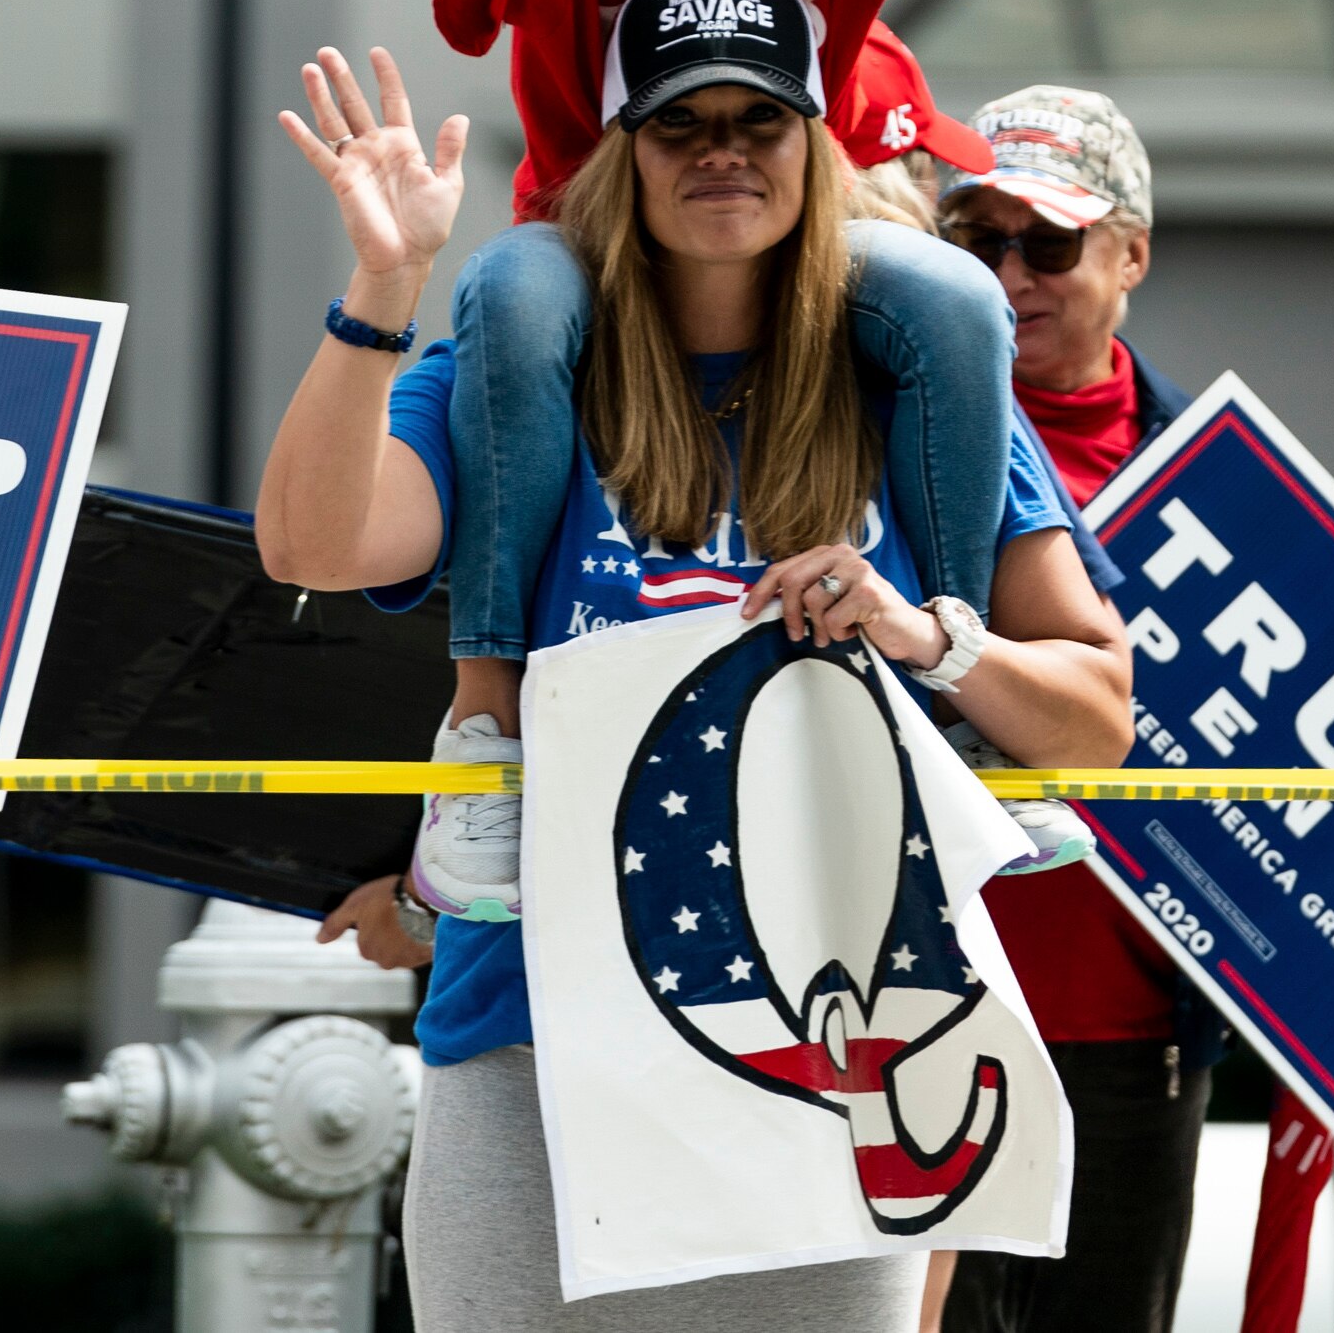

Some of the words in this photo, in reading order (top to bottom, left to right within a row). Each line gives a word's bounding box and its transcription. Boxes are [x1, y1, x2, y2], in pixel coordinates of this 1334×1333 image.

[696, 20, 739, 32] AGAIN
[879, 103, 917, 150] 45
[1201, 798, 1299, 895] MERICA
[1143, 882, 1215, 957] 2020
